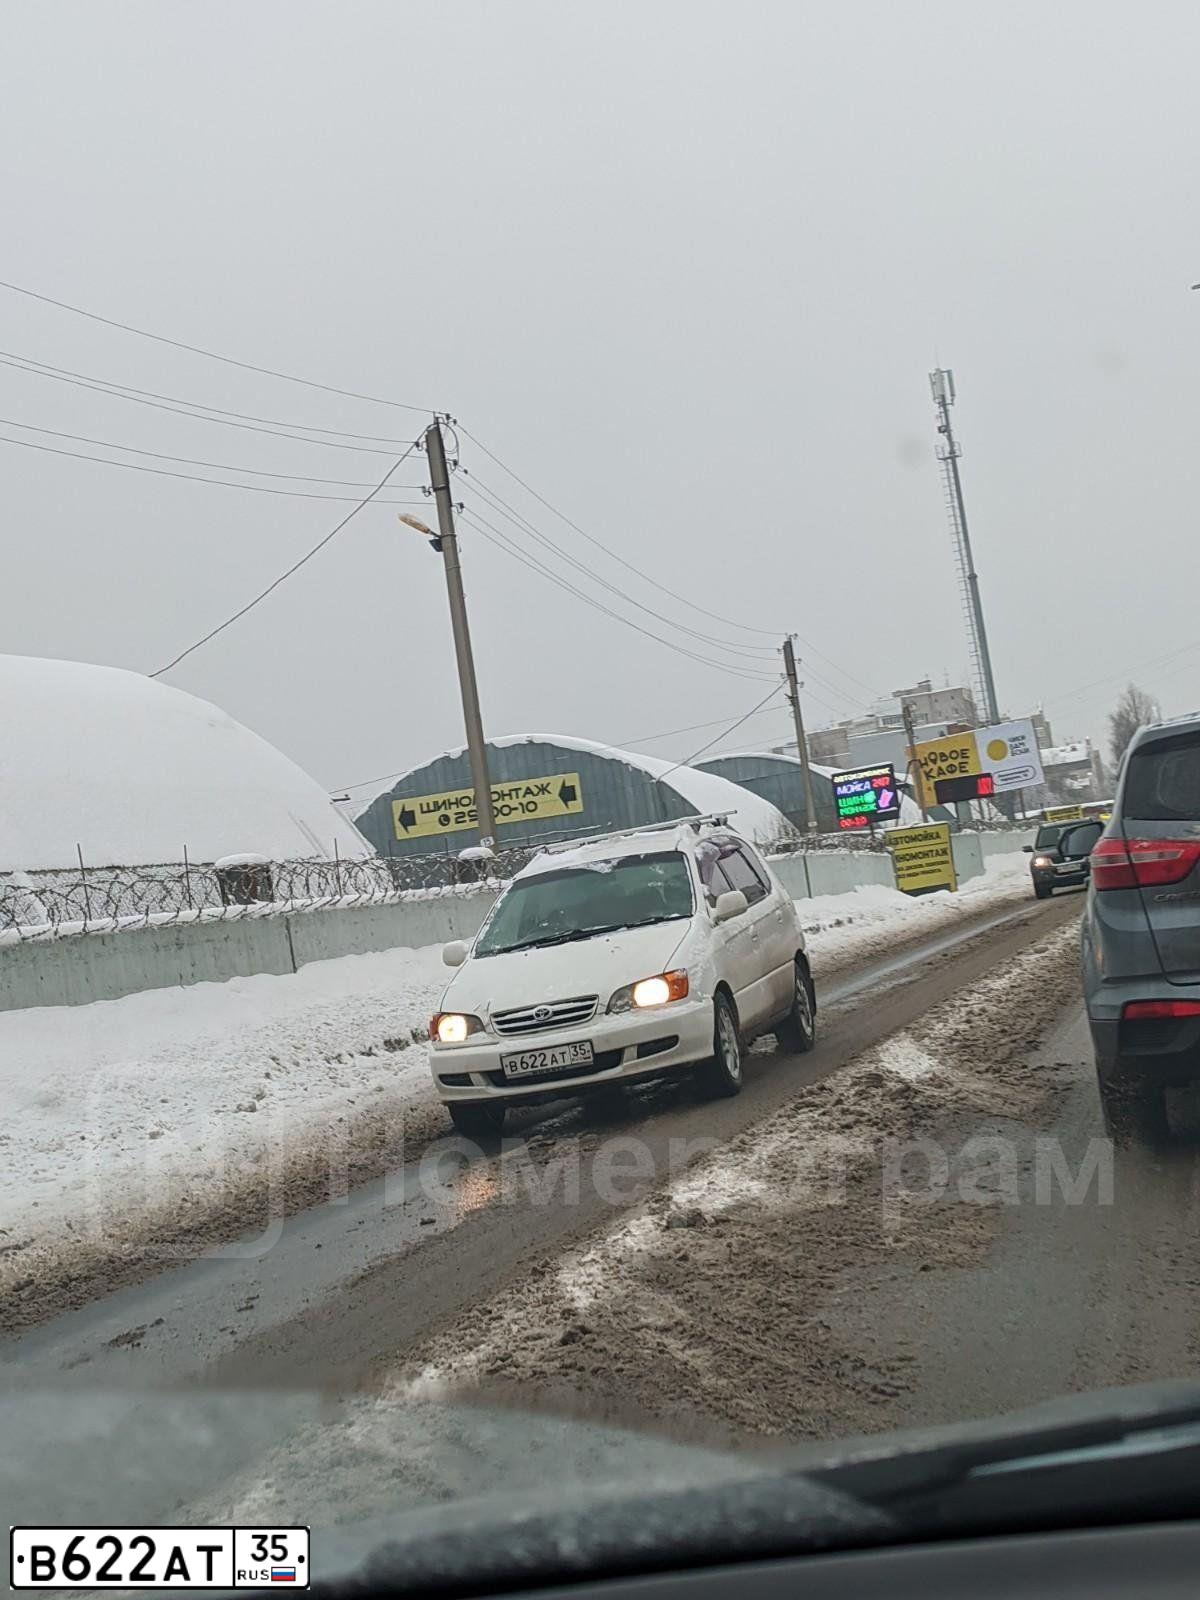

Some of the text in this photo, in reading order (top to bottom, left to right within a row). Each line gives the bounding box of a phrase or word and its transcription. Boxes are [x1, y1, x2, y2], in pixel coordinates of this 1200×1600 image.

[925, 762, 969, 781] КАФЕ
[419, 782, 552, 814] ШИНООНТАЖ
[836, 781, 871, 796] МОЙКА
[509, 1051, 567, 1073] В622АТ
[571, 1044, 586, 1057] 35
